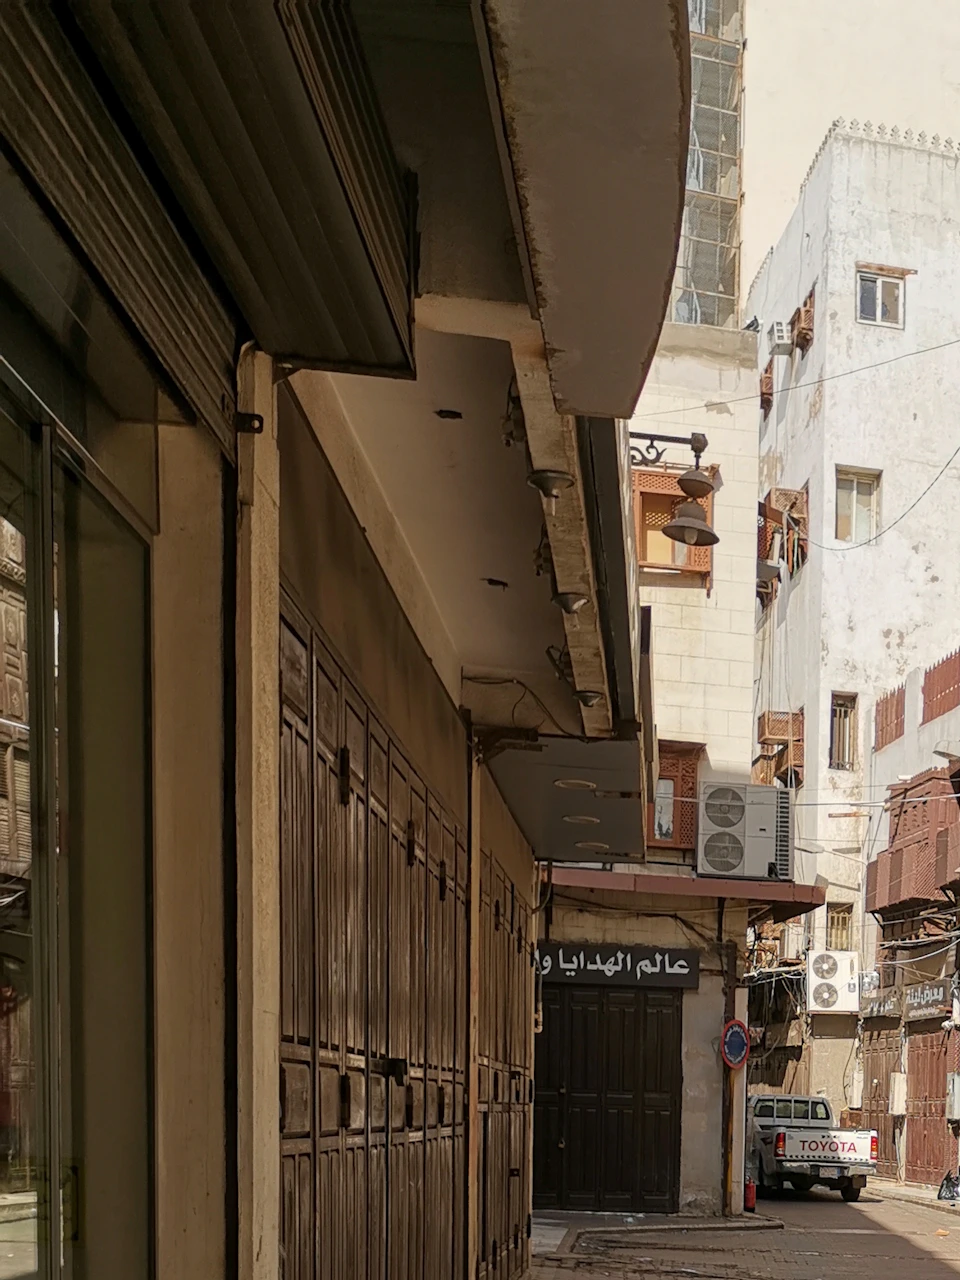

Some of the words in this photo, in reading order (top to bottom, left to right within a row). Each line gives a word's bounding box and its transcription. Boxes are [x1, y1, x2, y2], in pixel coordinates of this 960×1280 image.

[559, 948, 632, 977] الهدايا
[636, 951, 690, 981] عالم
[799, 1140, 858, 1153] TOYOTA
